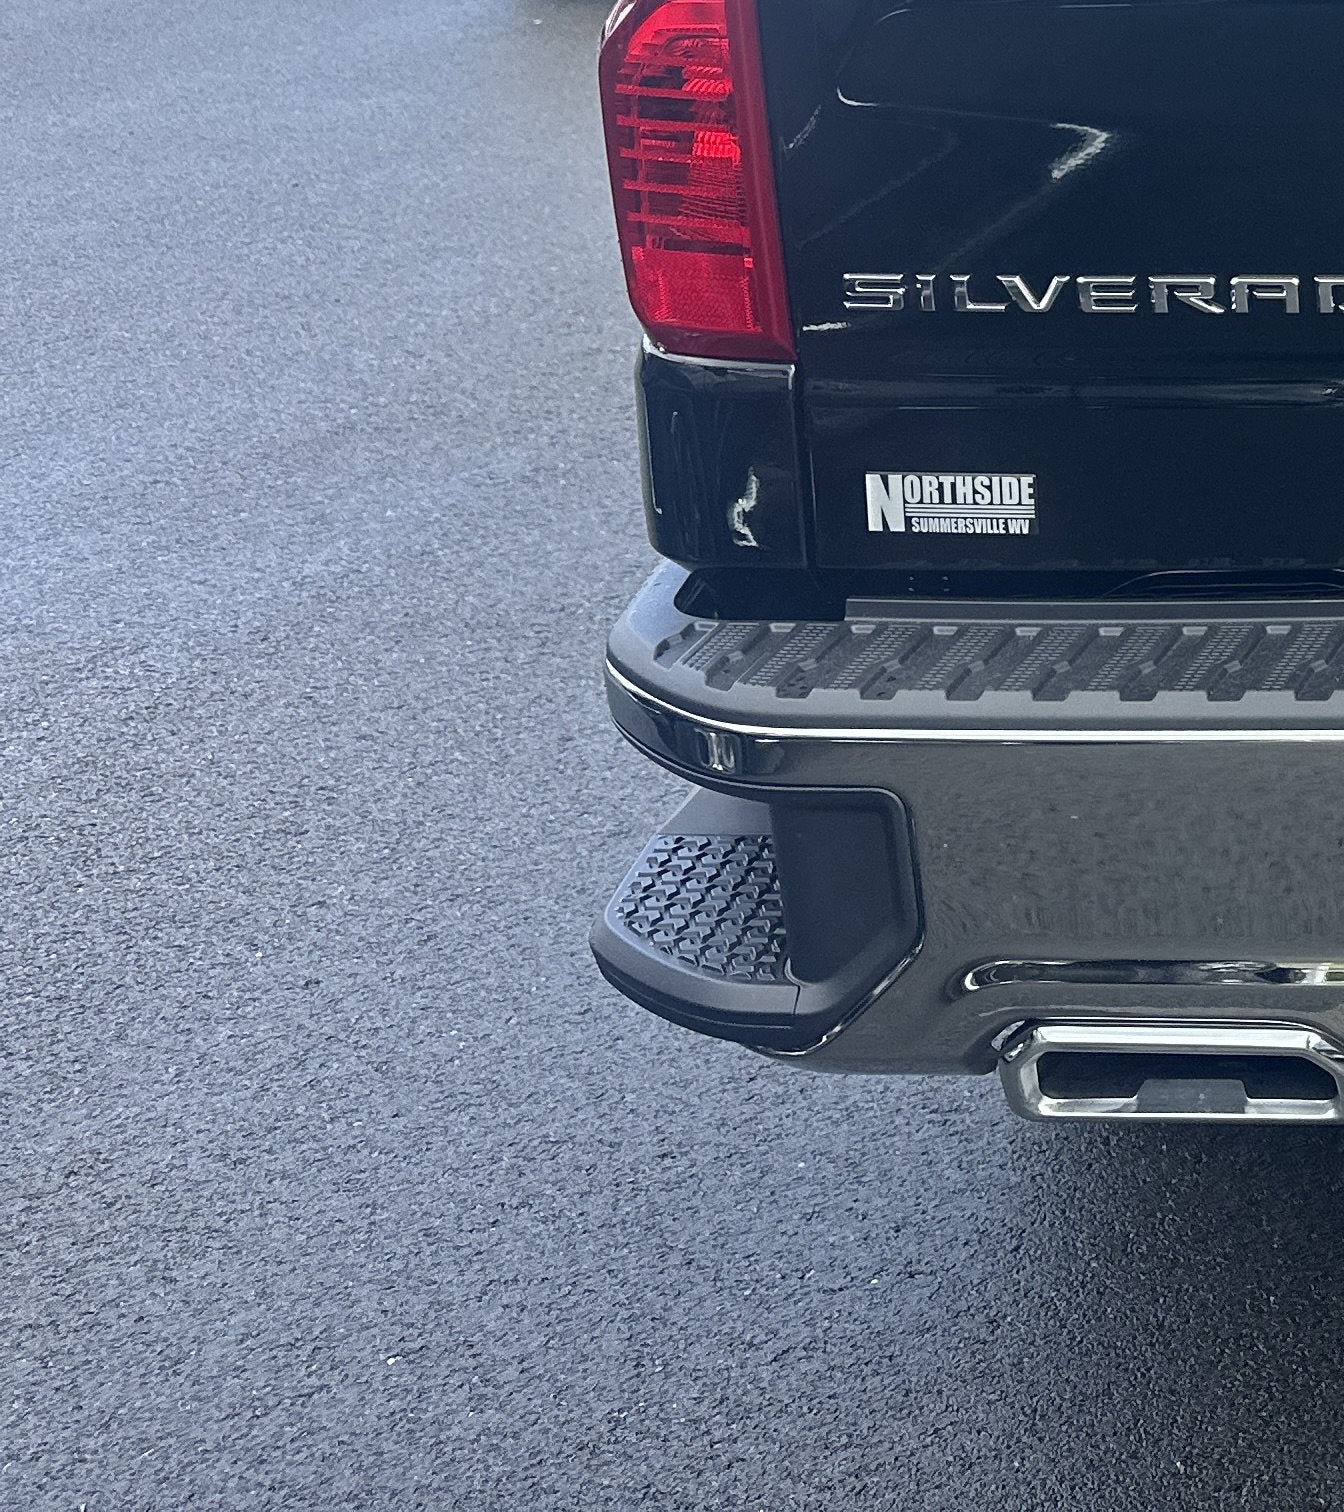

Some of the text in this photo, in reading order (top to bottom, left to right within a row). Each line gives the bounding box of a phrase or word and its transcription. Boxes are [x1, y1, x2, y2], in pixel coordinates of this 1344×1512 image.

[865, 473, 1036, 533] NORTHSIDE
[911, 517, 1031, 535] SUMMERSVILLE WV
